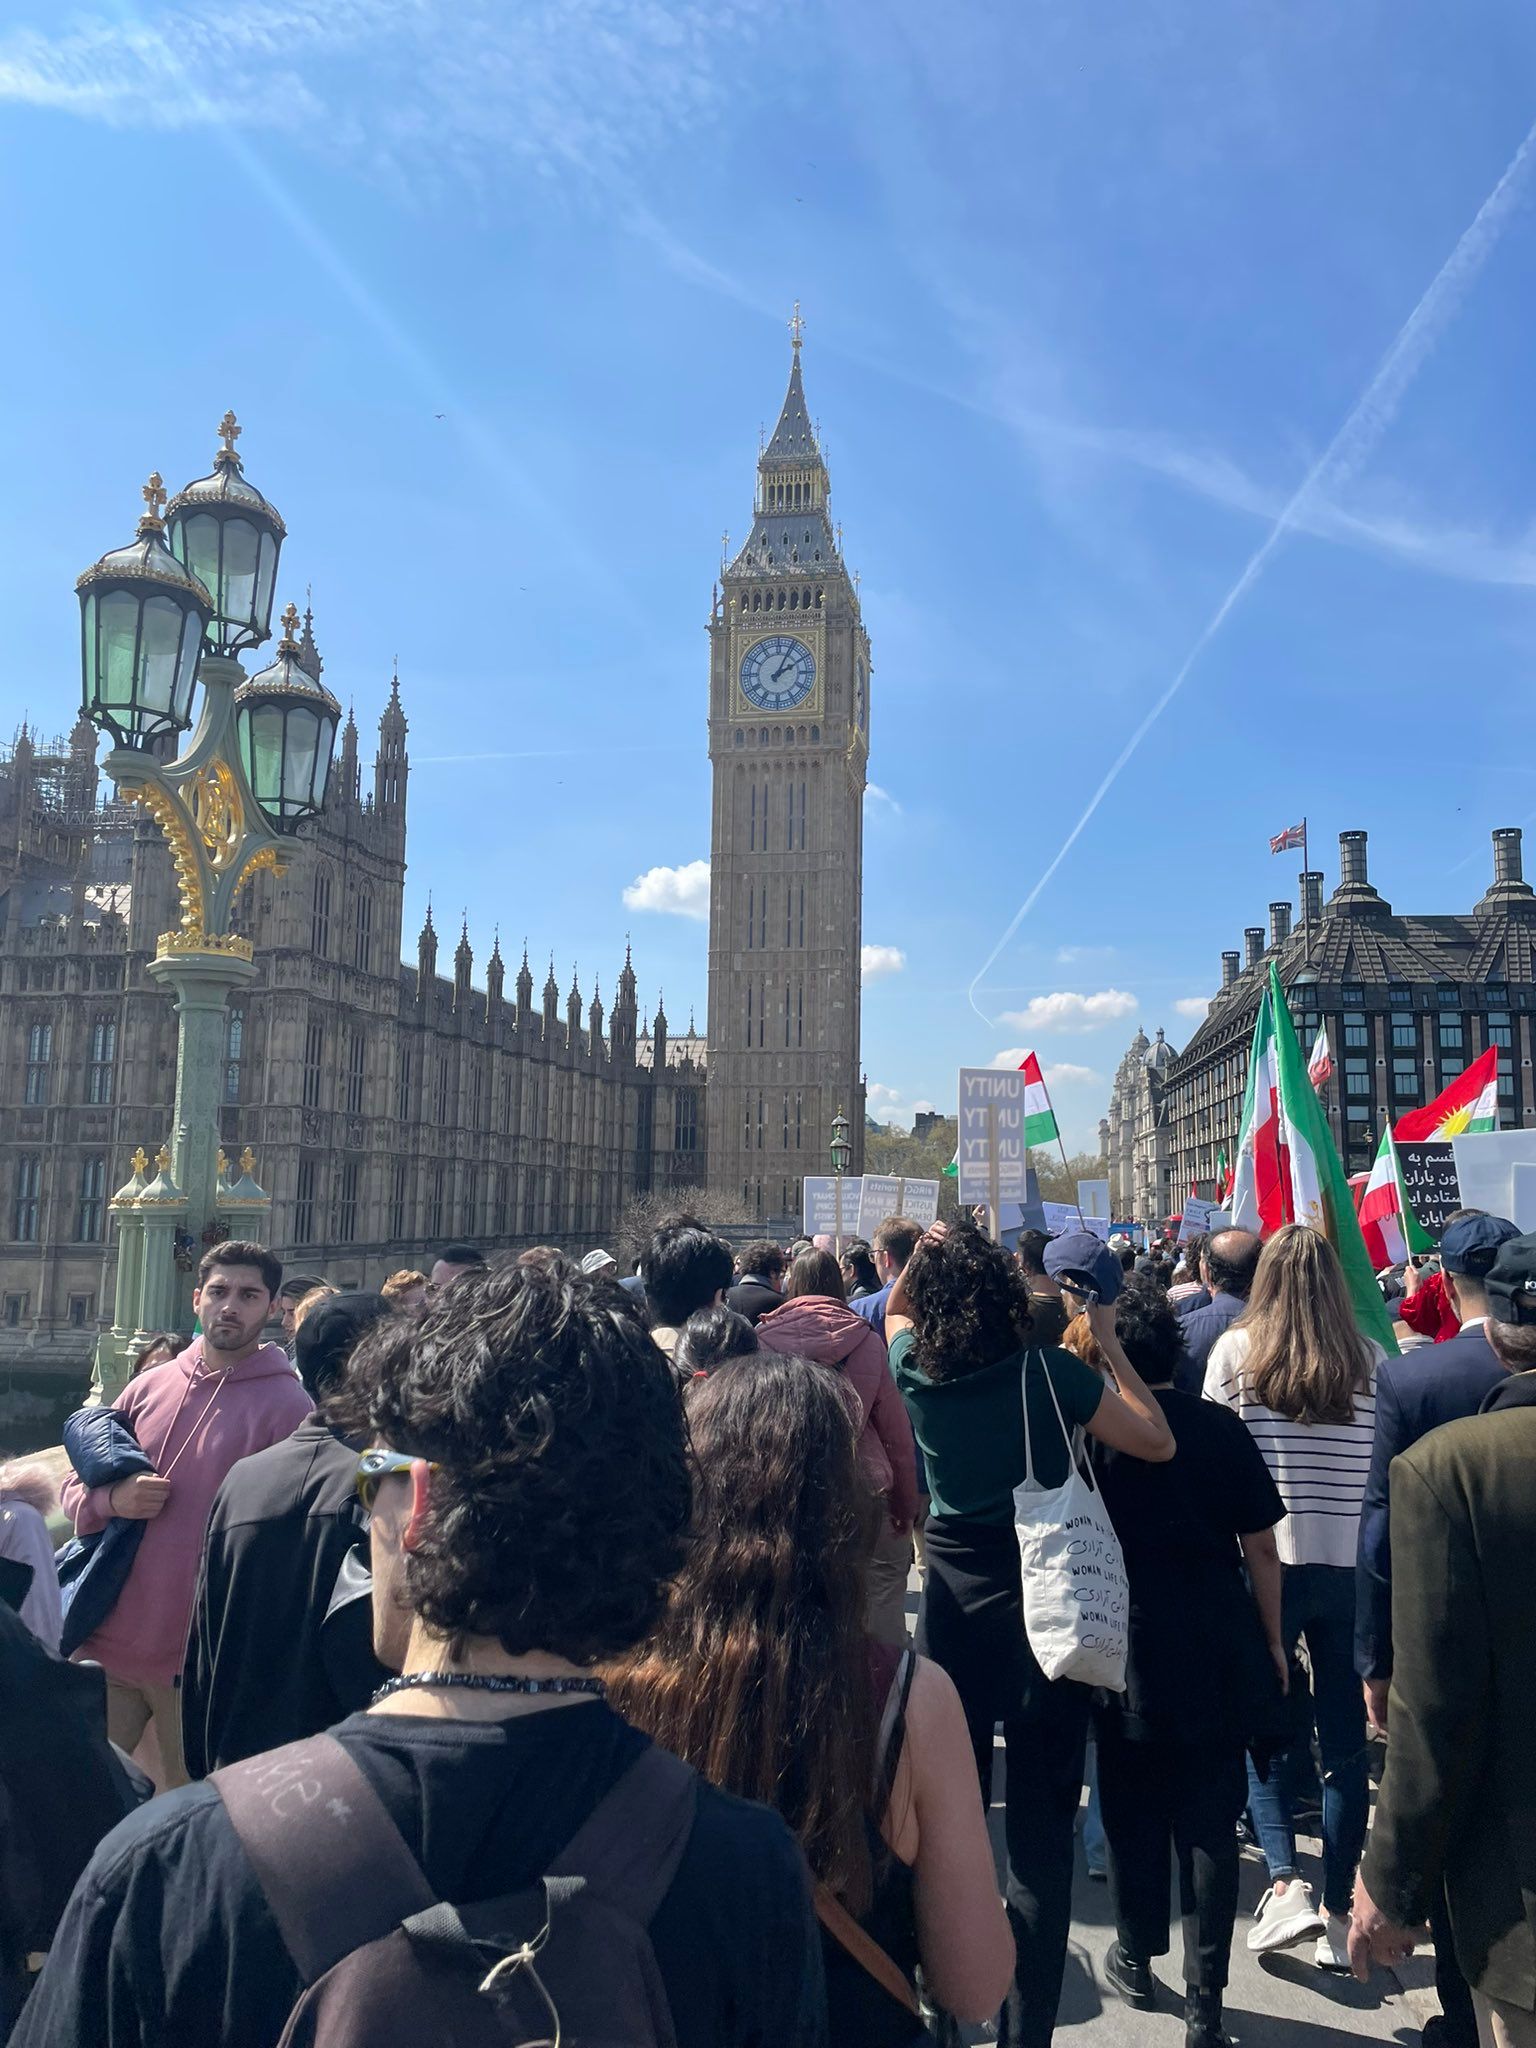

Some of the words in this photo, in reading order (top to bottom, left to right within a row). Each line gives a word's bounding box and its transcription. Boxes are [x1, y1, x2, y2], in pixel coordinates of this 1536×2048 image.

[1438, 1172, 1459, 1185] ون
[1072, 1565, 1101, 1577] WOMAN
[1081, 1611, 1108, 1625] WOMAN
